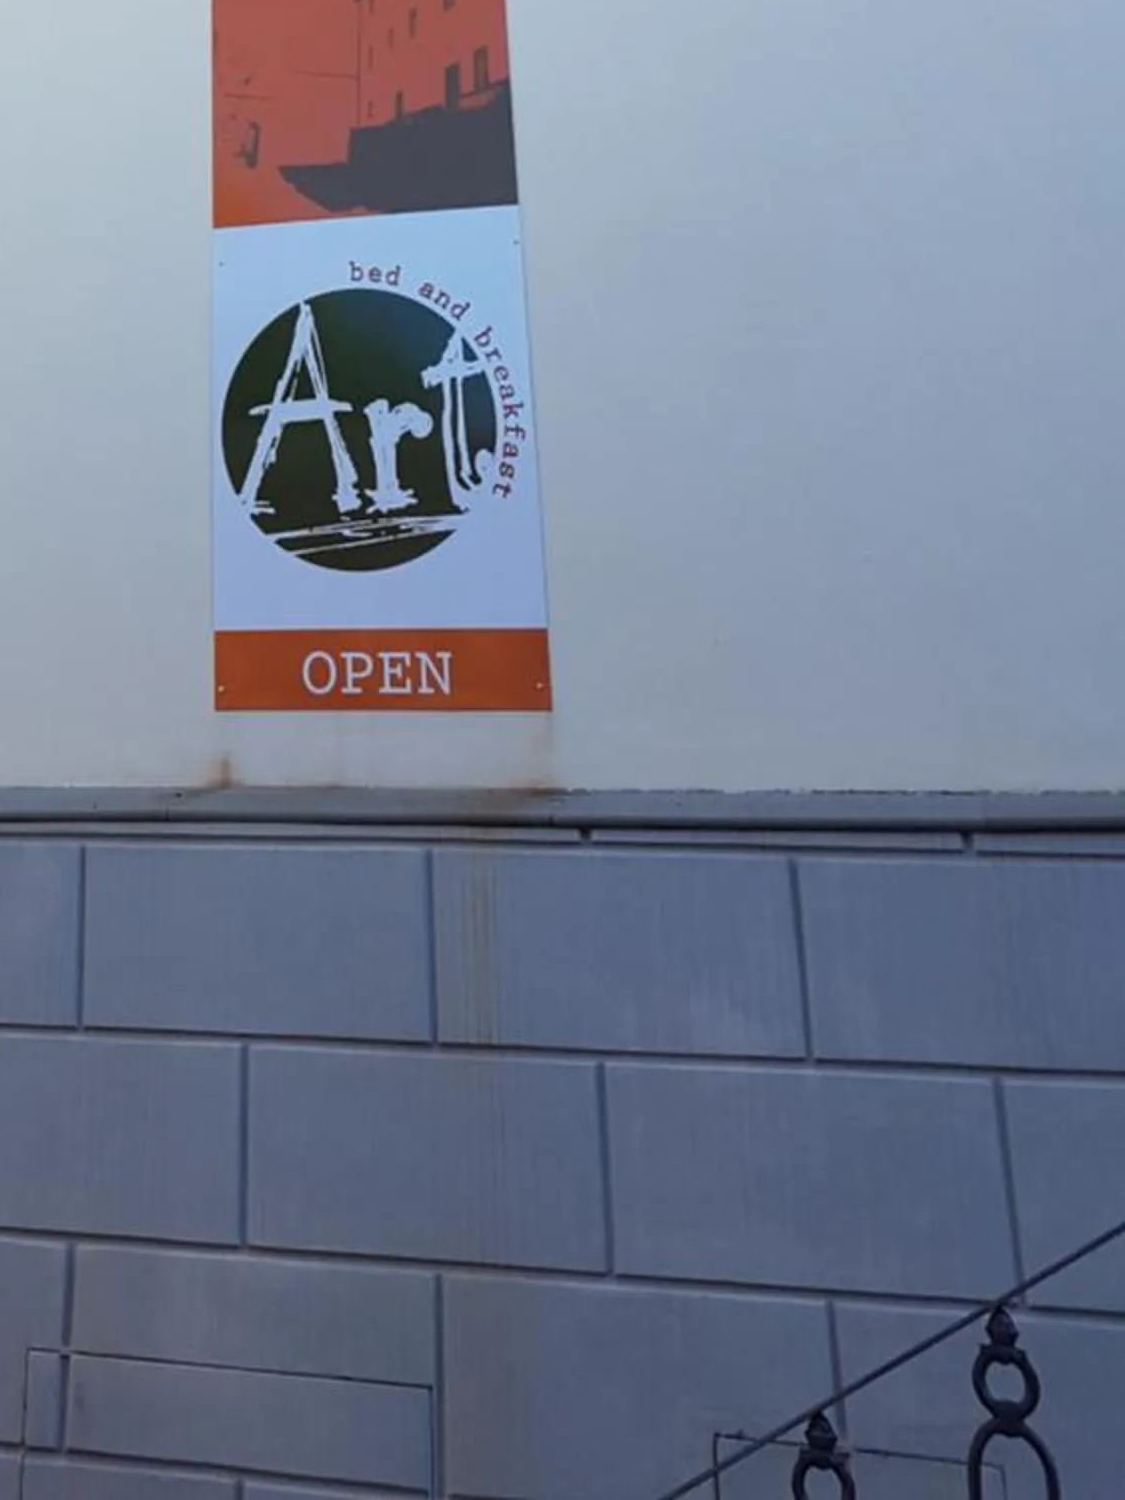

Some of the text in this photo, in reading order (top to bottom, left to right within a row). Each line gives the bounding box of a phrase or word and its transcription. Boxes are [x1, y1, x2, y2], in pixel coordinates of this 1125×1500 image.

[239, 301, 497, 514] Art
[349, 261, 525, 499] bed and breakfast
[302, 651, 453, 695] OPEN
